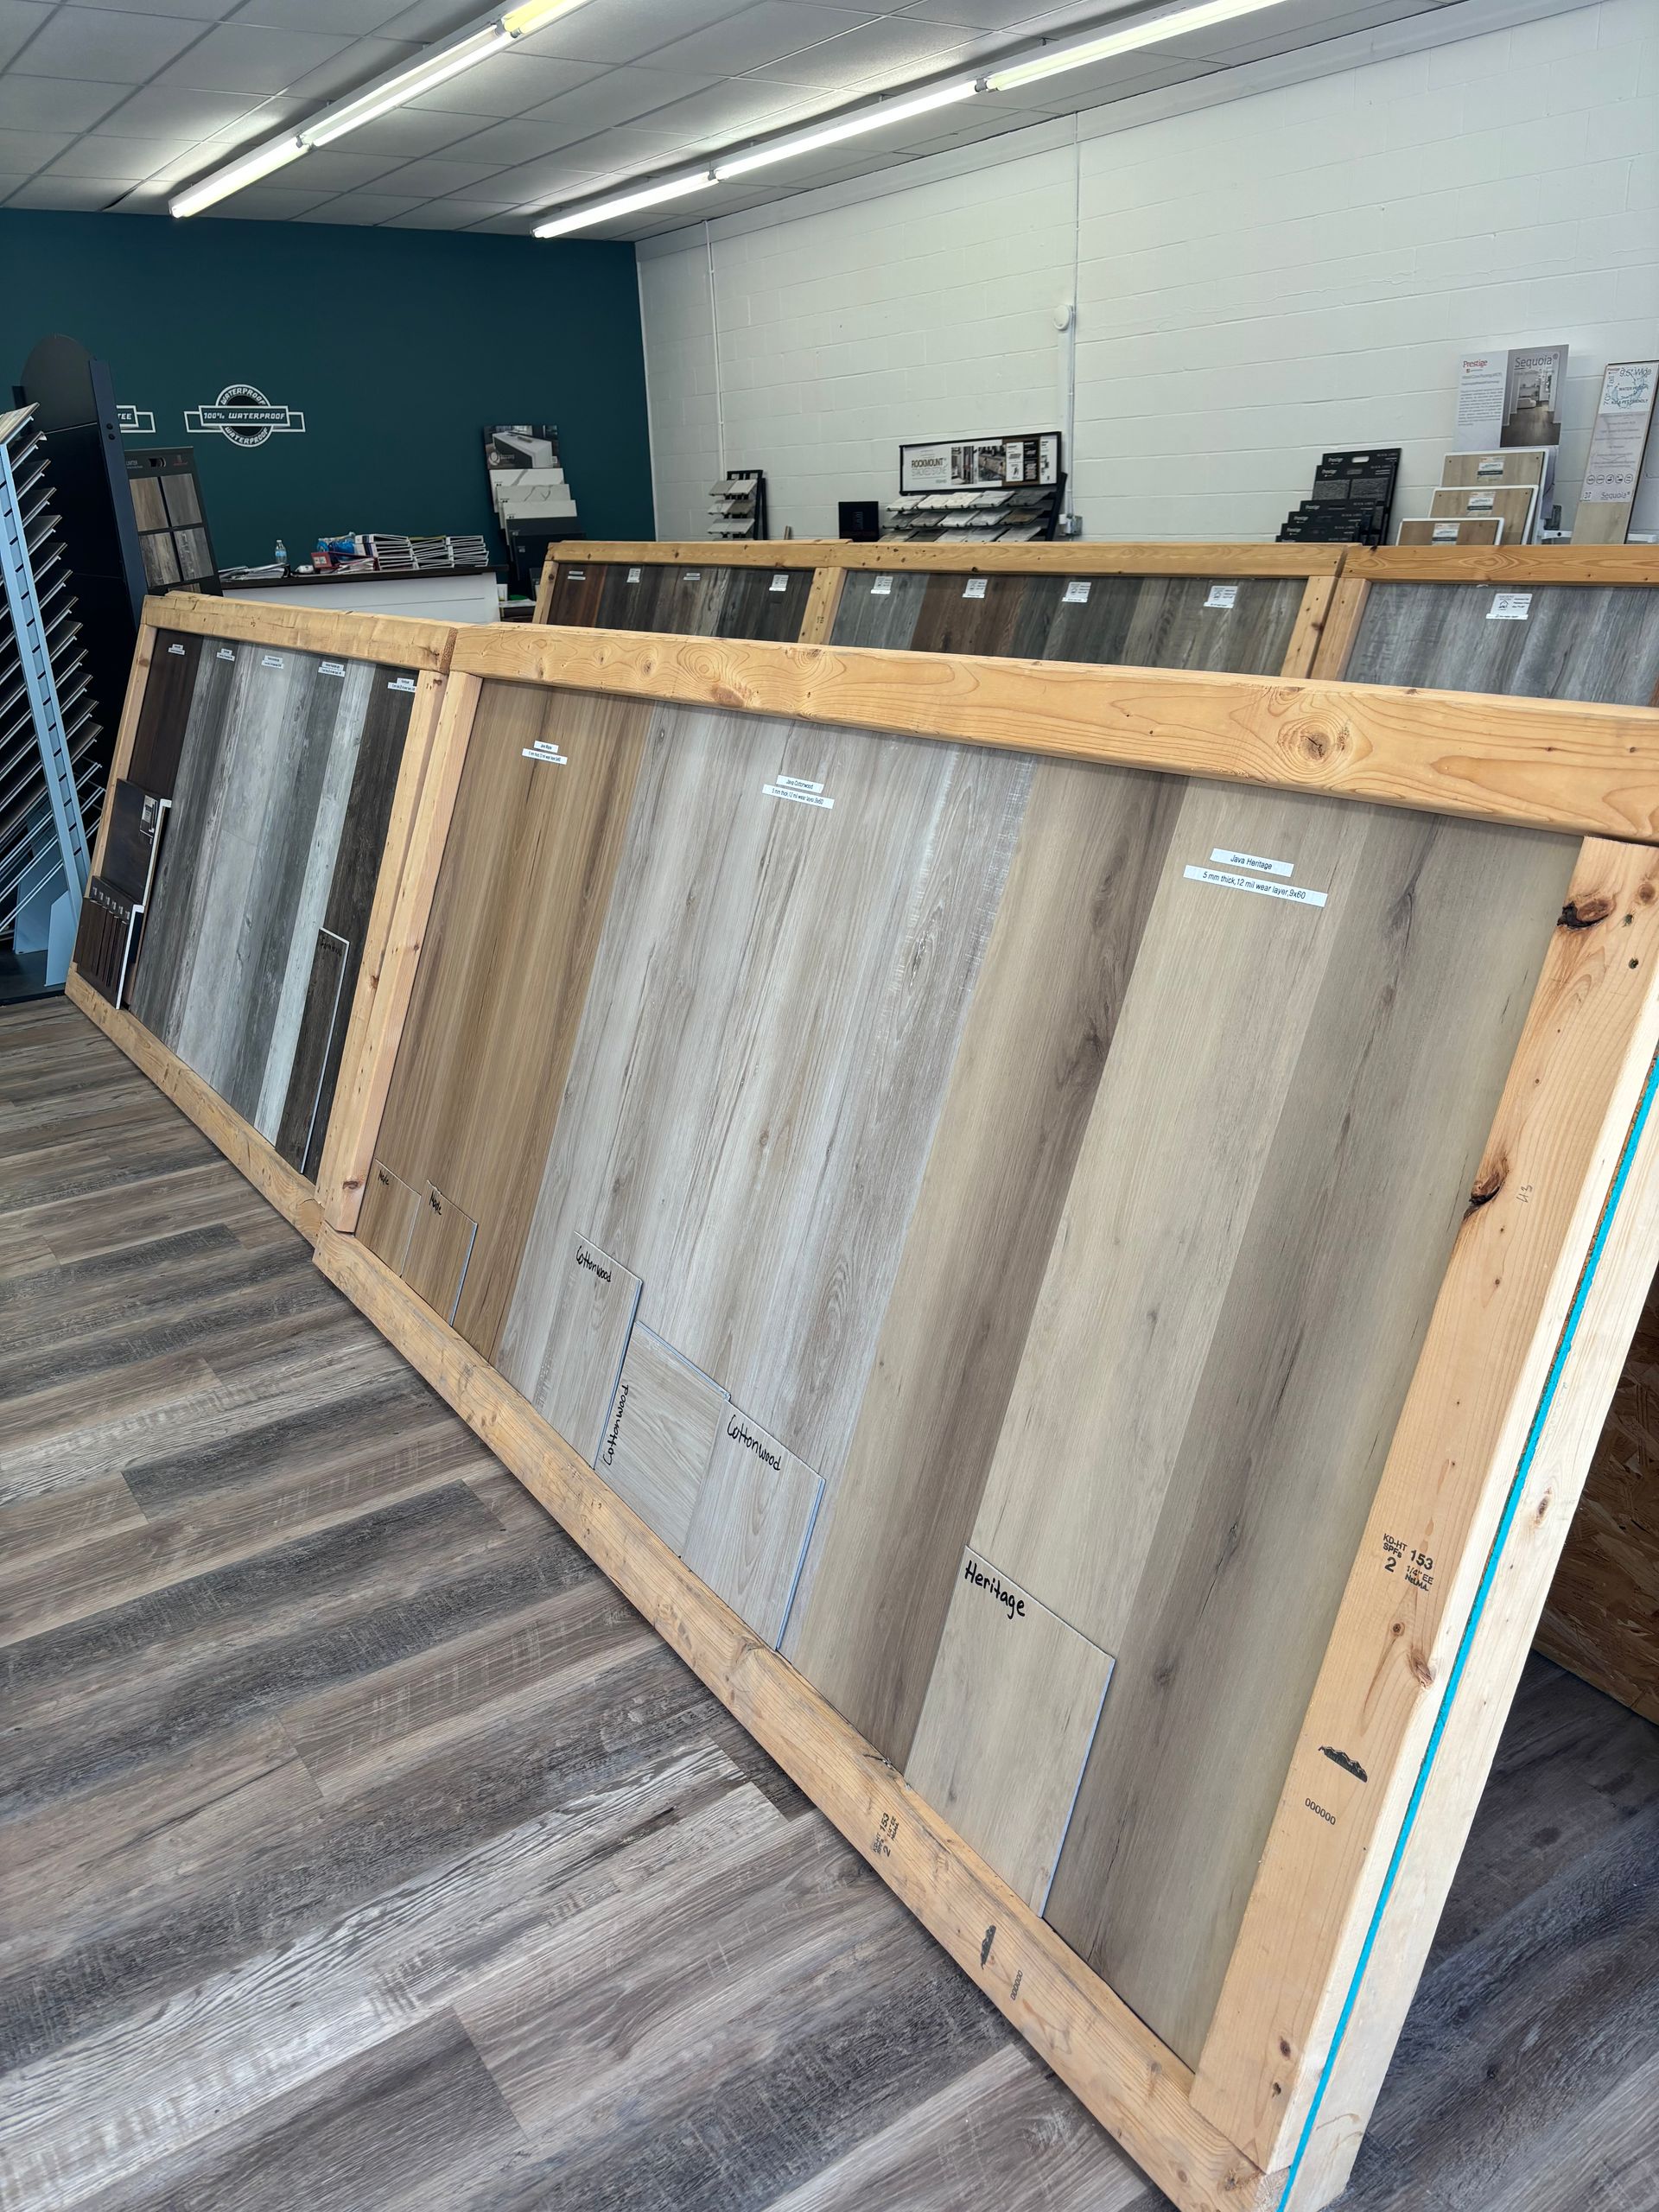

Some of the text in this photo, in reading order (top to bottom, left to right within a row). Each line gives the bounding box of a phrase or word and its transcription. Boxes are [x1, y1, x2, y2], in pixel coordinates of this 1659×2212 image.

[220, 387, 266, 405] WATERPROOF
[225, 427, 268, 445] WATERPROOF
[1230, 855, 1273, 870] Java Heritage
[1245, 879, 1255, 889] mil
[1256, 882, 1272, 893] wear
[575, 1245, 612, 1283] Cottonwood
[602, 1384, 629, 1466] Cottonwood
[727, 1414, 781, 1471] Cottonwood
[1382, 1533, 1408, 1552] KD-HT
[1384, 1556, 1397, 1573] 2
[1410, 1549, 1433, 1571] 153
[1422, 1573, 1434, 1586] EE
[964, 1560, 1026, 1620] Heritage
[880, 1812, 890, 1832] 153
[883, 1845, 891, 1857] 2
